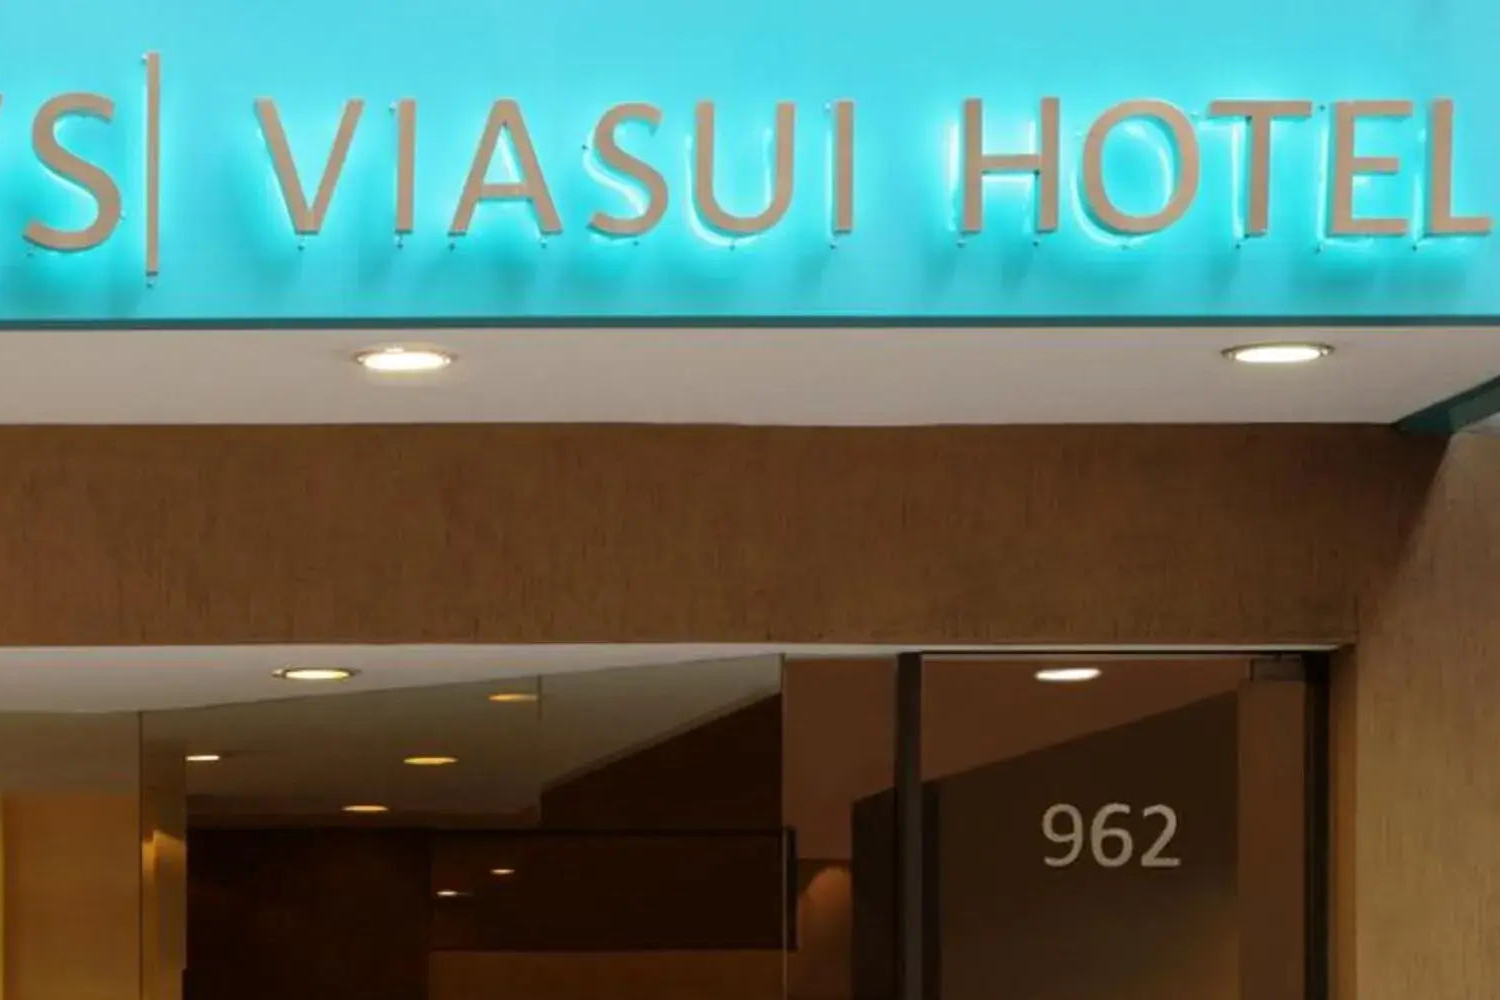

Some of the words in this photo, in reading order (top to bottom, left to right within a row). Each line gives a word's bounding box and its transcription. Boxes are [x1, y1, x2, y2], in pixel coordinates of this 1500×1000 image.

[253, 98, 854, 239] VIASUI
[959, 95, 1493, 238] HOTEL
[1042, 803, 1181, 867] 962
